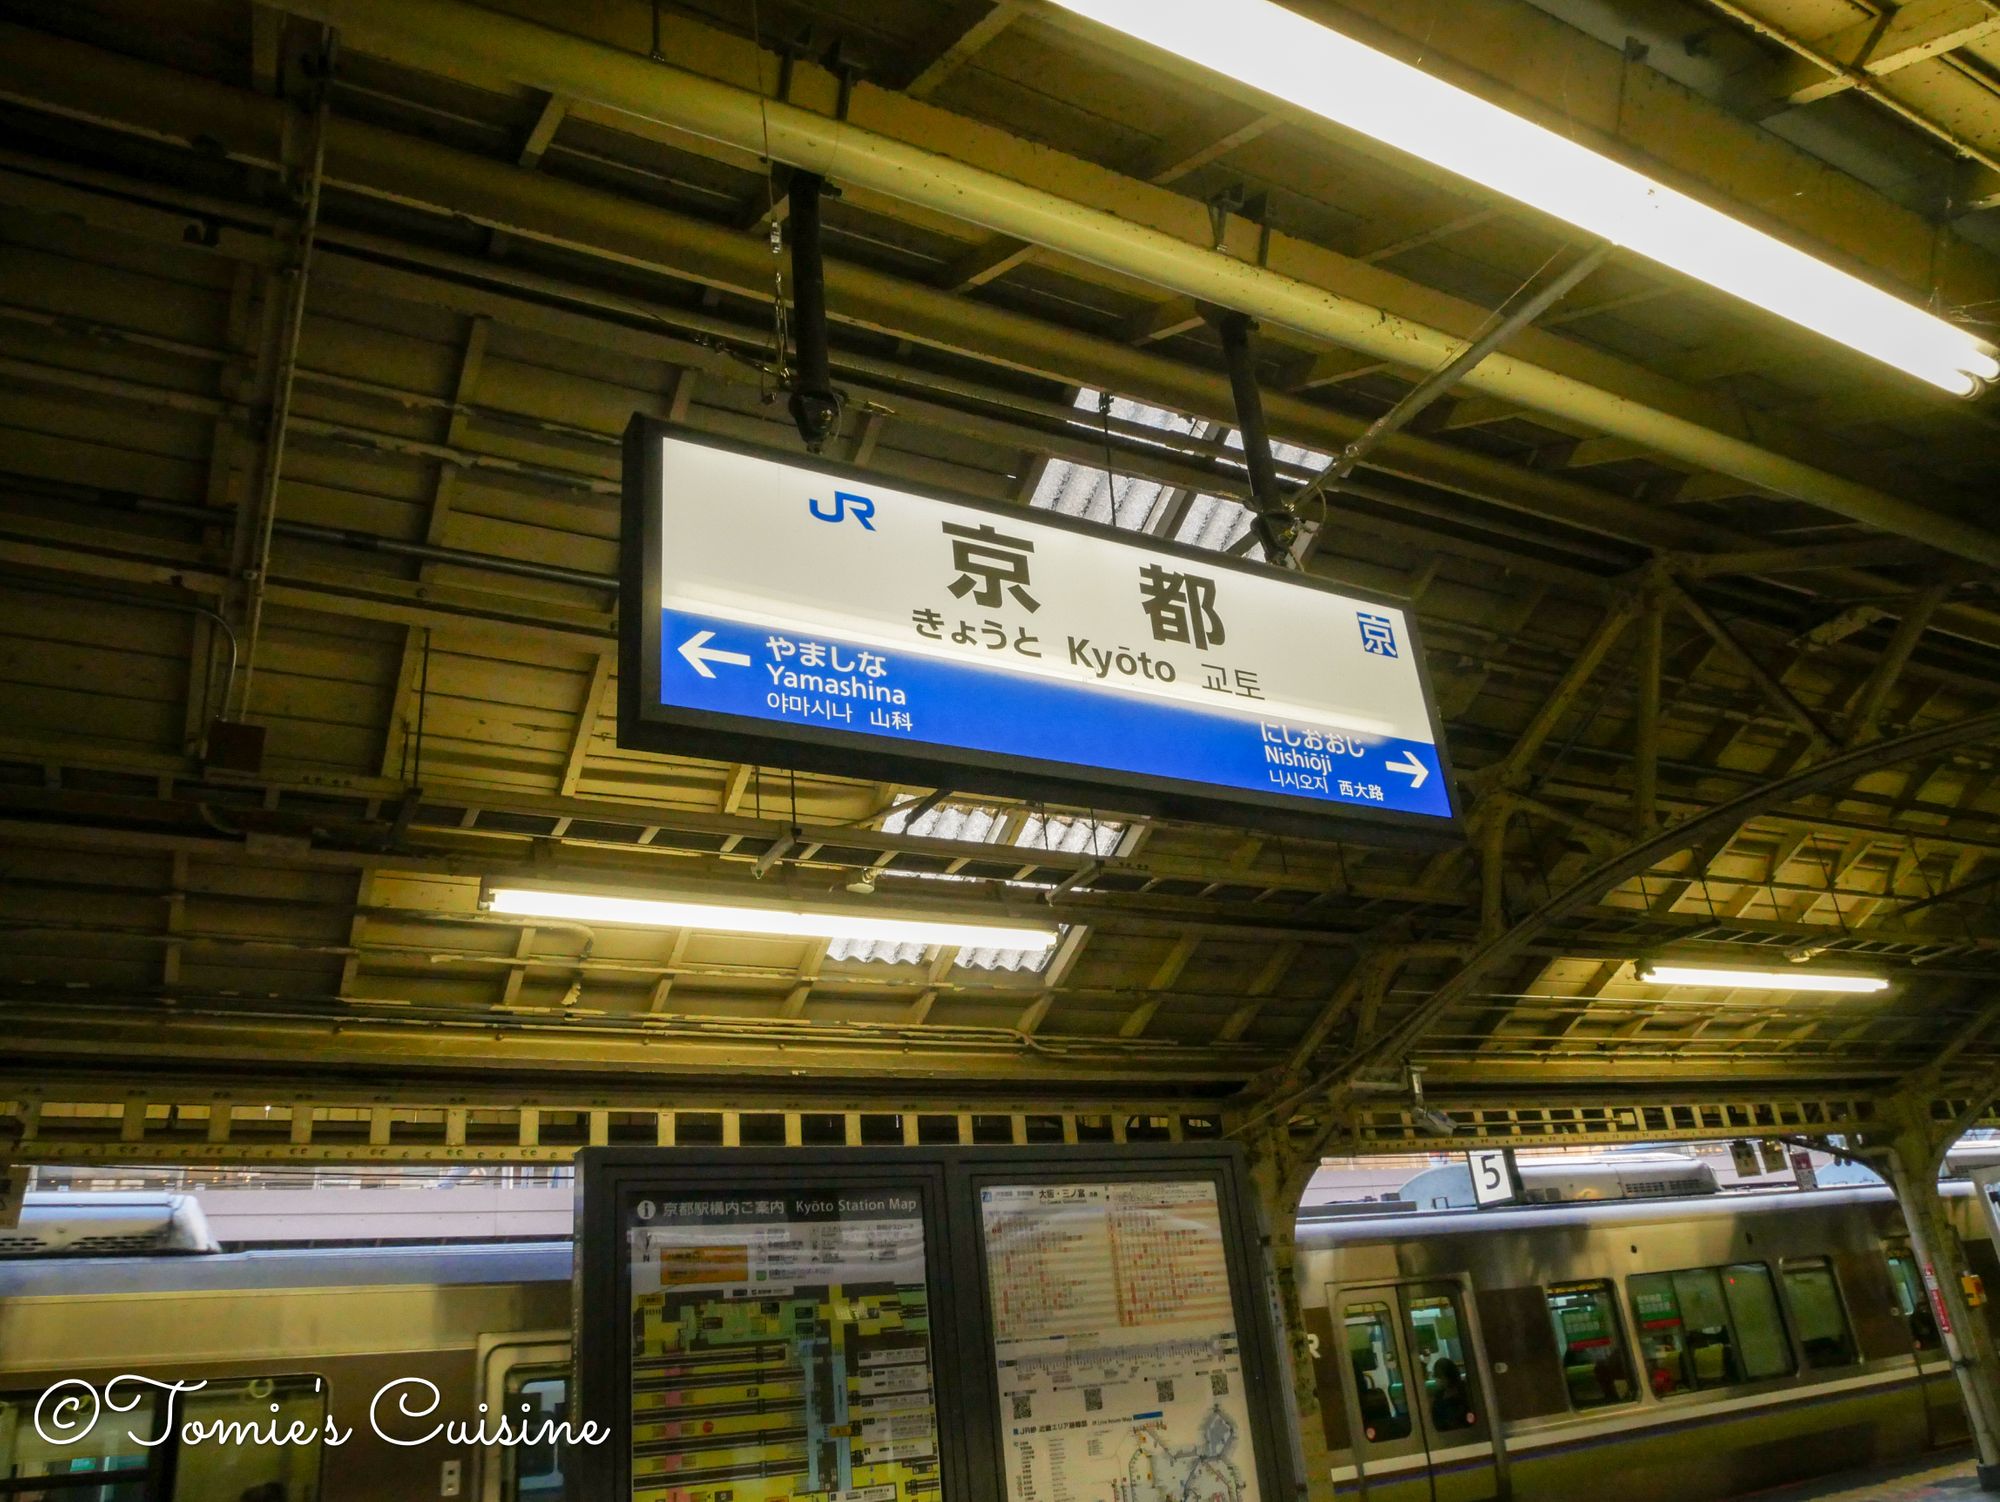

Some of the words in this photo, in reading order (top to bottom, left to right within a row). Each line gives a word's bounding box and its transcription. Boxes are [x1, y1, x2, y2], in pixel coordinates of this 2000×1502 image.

[809, 490, 876, 532] JR
[912, 608, 1042, 659] きょうと
[1067, 636, 1177, 683] Kyōto
[1200, 663, 1266, 700] 교토
[1358, 615, 1397, 656] 京
[765, 635, 887, 678] やましな
[766, 663, 907, 706] Yamashina
[766, 692, 852, 723] 야마시나
[869, 707, 913, 732] 山科
[1260, 721, 1365, 758] にしおおじ
[1264, 745, 1332, 776] Nishiōji
[1269, 769, 1329, 794] 니시오지
[1337, 779, 1385, 801] 西大路
[1481, 1154, 1501, 1189] 5
[662, 1200, 785, 1216] 京都駅構内ご案内
[838, 1199, 885, 1212] Station
[889, 1197, 917, 1211] Map
